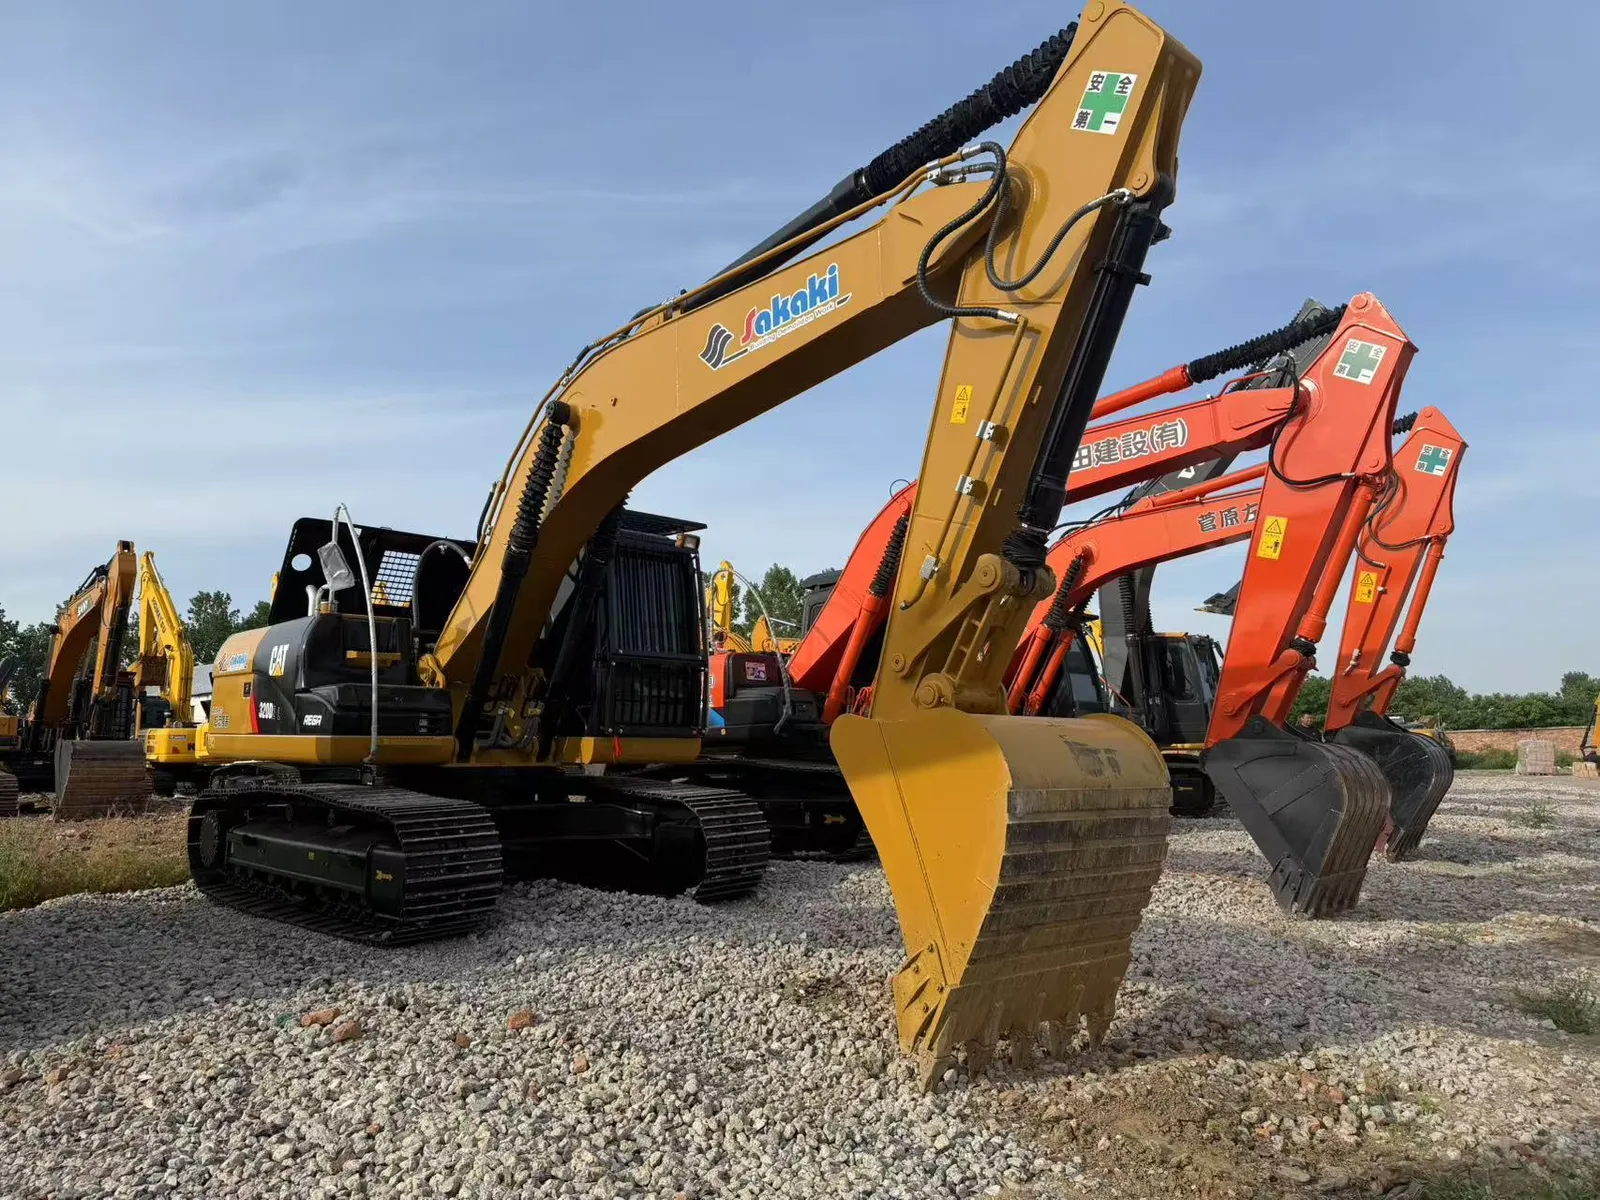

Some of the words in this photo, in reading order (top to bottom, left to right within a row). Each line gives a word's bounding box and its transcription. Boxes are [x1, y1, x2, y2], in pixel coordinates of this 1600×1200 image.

[740, 263, 839, 346] Sakaki
[815, 301, 835, 318] Work
[269, 644, 291, 677] CAT
